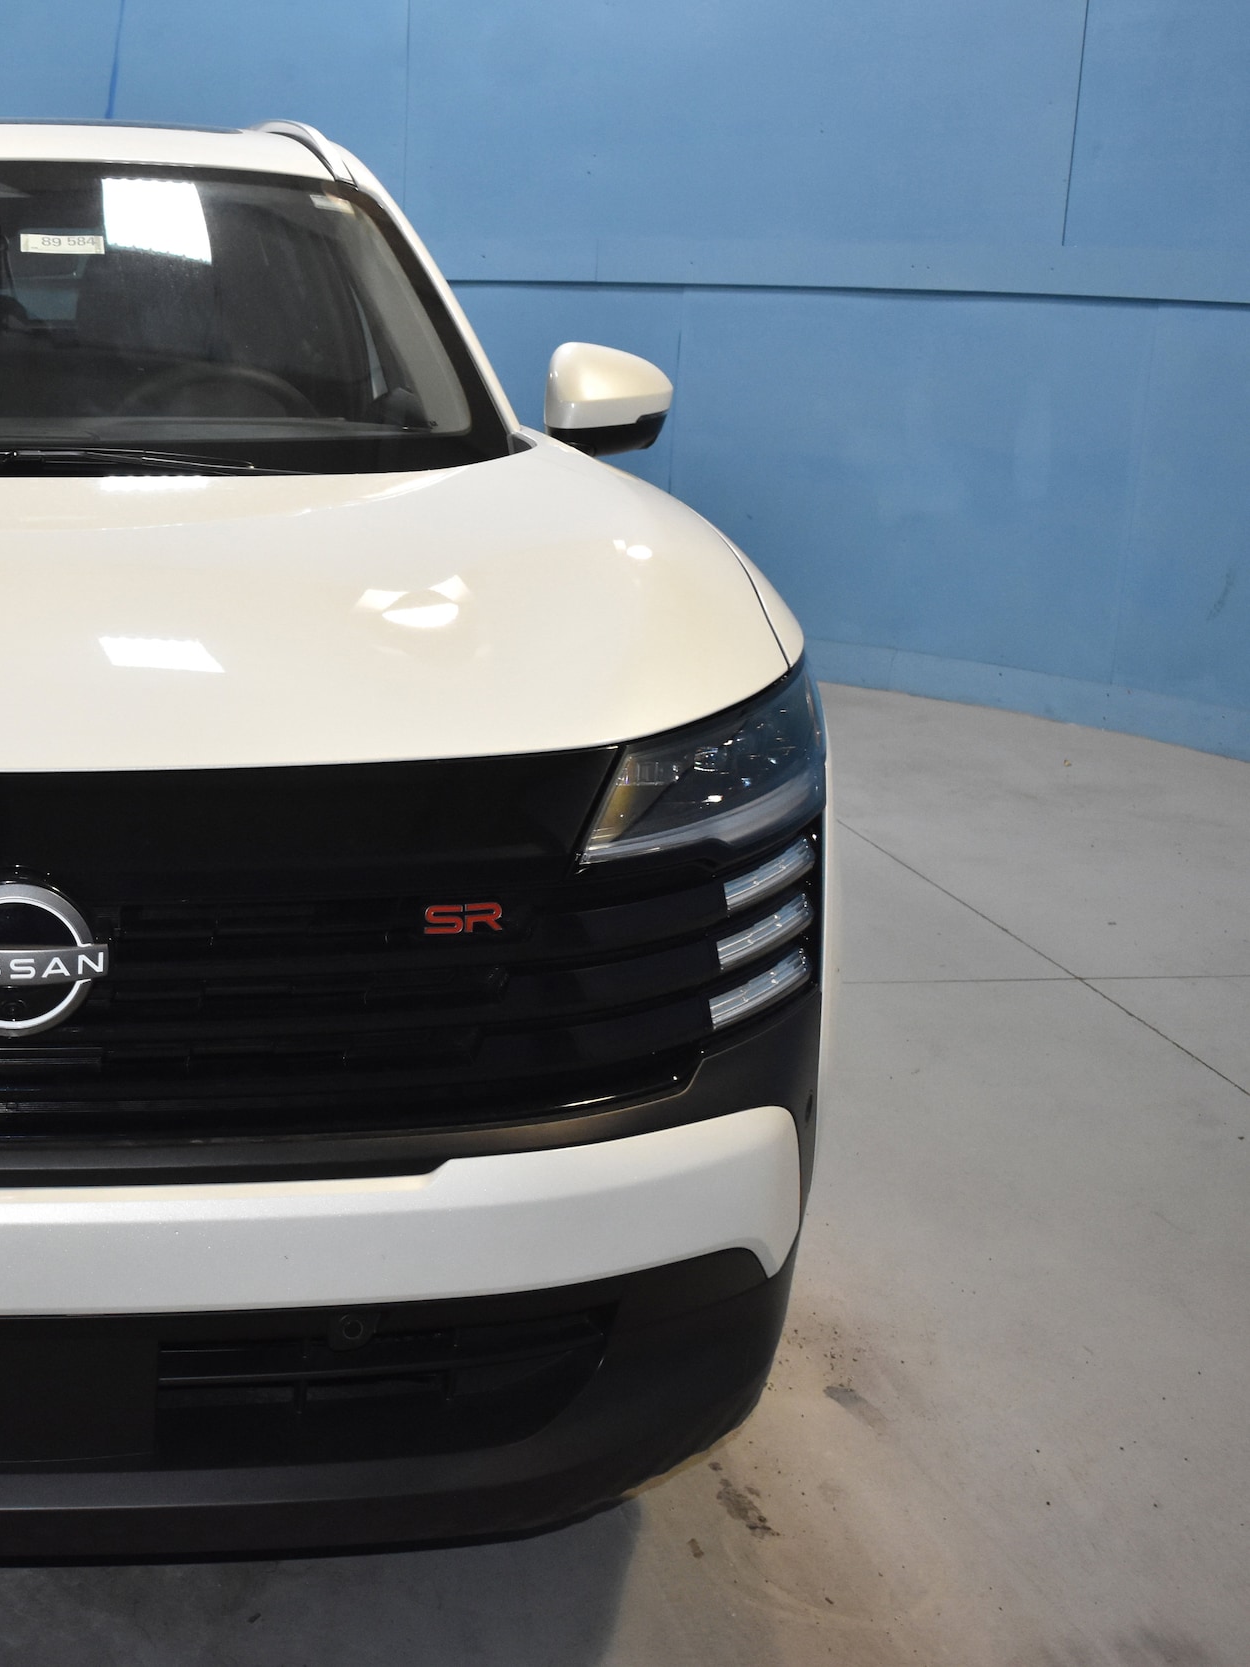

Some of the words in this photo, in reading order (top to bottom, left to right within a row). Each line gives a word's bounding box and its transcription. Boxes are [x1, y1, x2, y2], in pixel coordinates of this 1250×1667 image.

[41, 236, 62, 247] 89
[67, 236, 96, 246] 584
[424, 902, 503, 934] SR
